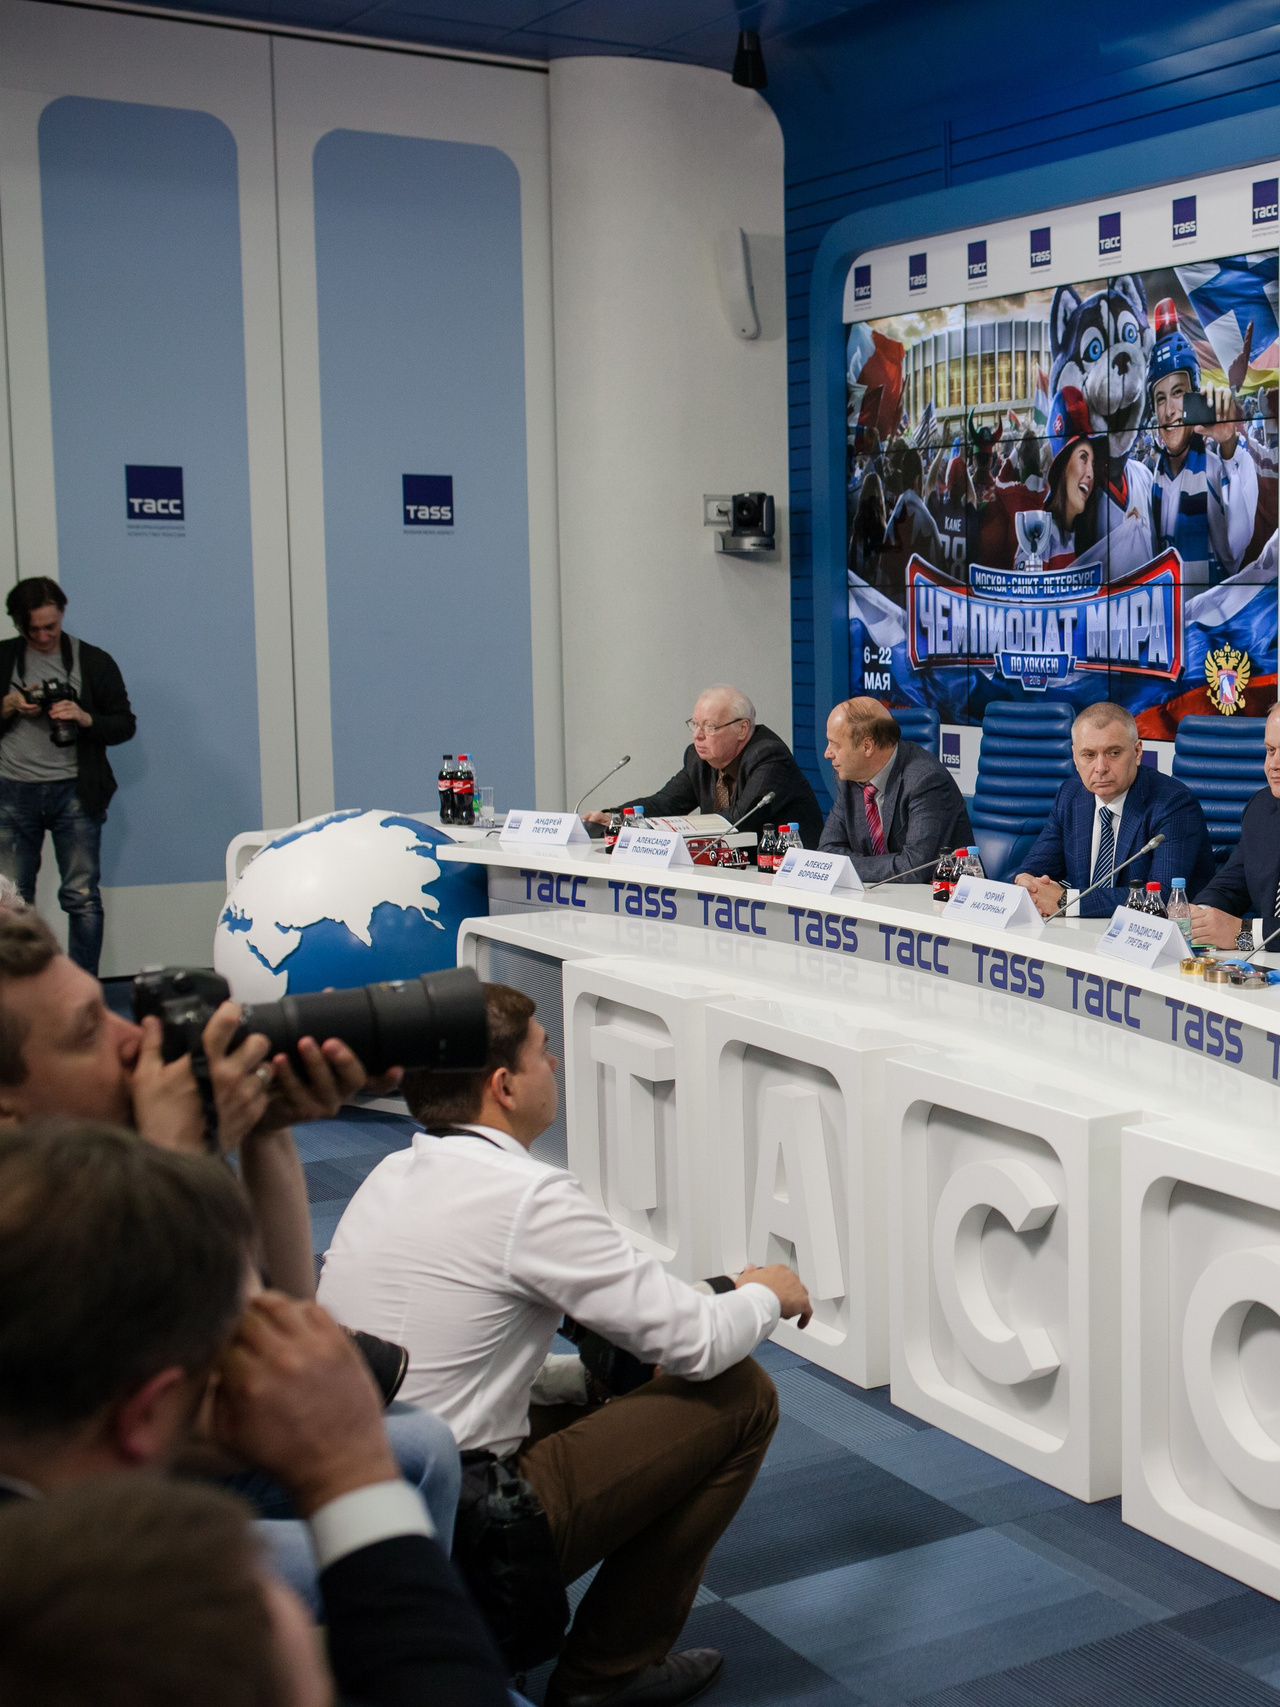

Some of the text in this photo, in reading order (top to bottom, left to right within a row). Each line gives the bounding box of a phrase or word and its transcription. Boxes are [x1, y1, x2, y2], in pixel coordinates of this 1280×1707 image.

[944, 515, 962, 532] KANE
[975, 571, 1007, 593] МОСКВА
[918, 582, 1169, 664] ЧЕМПИОНАТ МИРА
[1010, 656, 1059, 673] ПО ХОККЕЮ
[864, 671, 891, 691] МАЯ
[535, 817, 562, 827] АНДРЕЙ
[532, 826, 558, 835] ПЕТРОВ
[636, 836, 671, 847] АЛЕКСАНДР
[804, 859, 833, 871] АЛЕКСЕЙ
[984, 891, 1006, 903] ЮРИЙ
[970, 901, 1007, 915] НАГОРНЫХ
[1128, 922, 1164, 942] ВЛАДИСЛАВ
[1125, 936, 1153, 951] ТРЕТЬЯК
